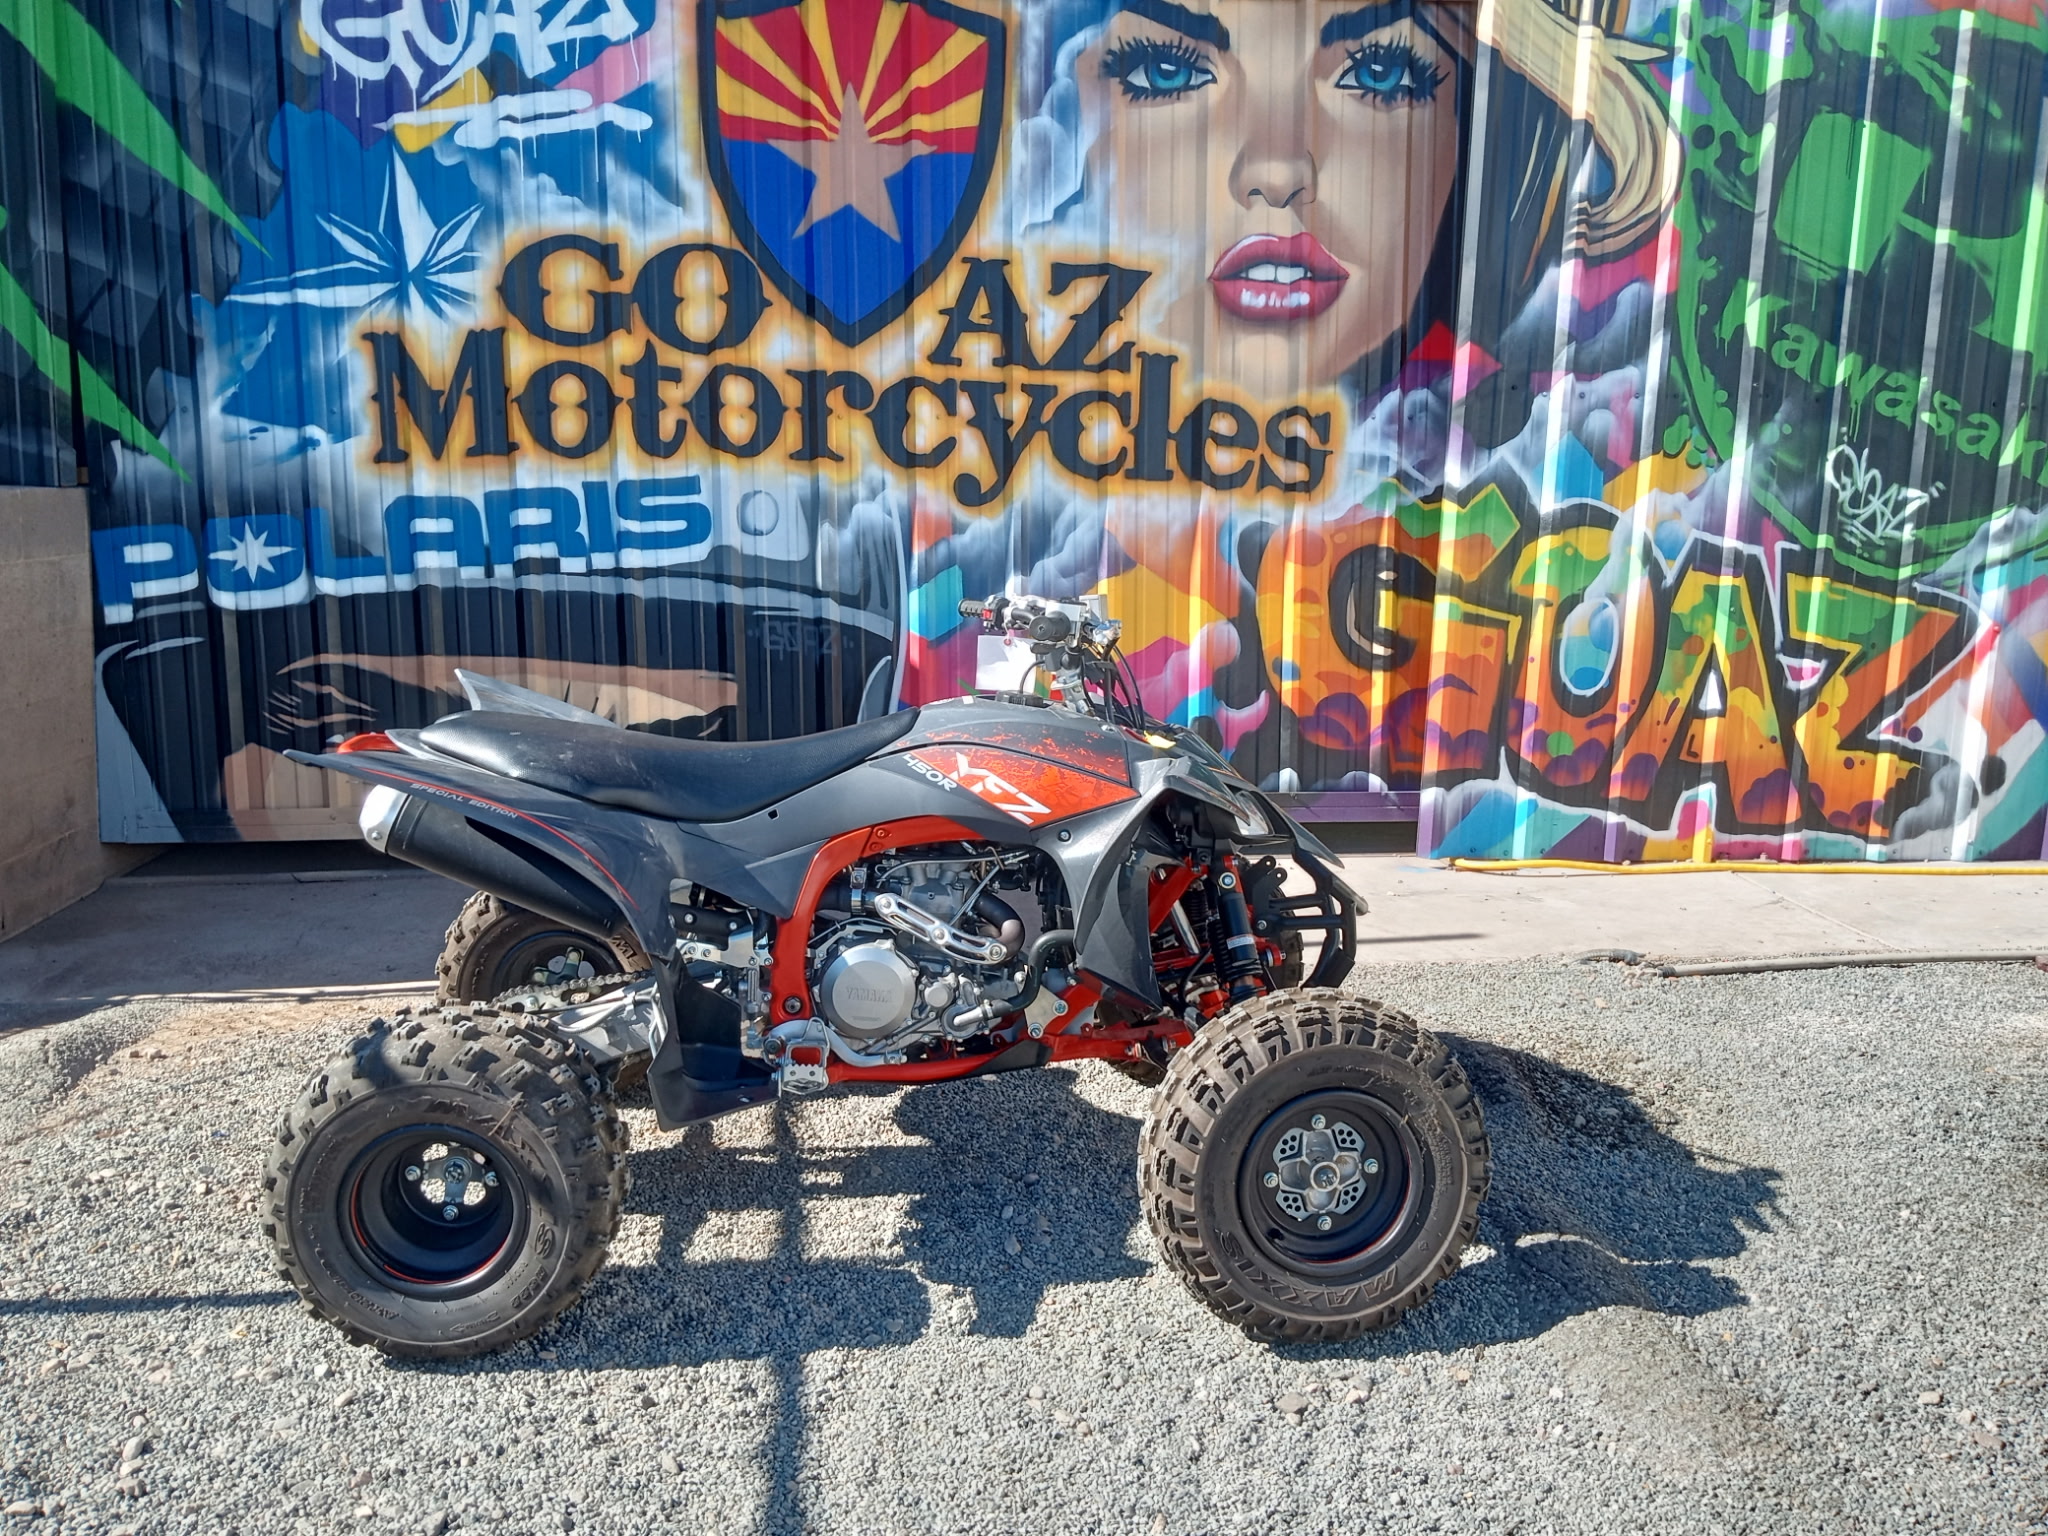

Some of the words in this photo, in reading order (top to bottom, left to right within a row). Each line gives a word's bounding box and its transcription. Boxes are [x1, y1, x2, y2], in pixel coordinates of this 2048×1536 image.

[497, 234, 773, 355] GO
[927, 257, 1152, 372] AZ
[362, 327, 1333, 507] Motorcycles
[91, 475, 712, 623] POLARIS
[1256, 483, 1960, 836] GOAZ
[410, 783, 464, 802] SPECIAL
[468, 799, 518, 819] EDITION
[902, 753, 957, 792] 450R
[950, 752, 1052, 825] YFZ
[1214, 1229, 1398, 1308] MAXXIS
